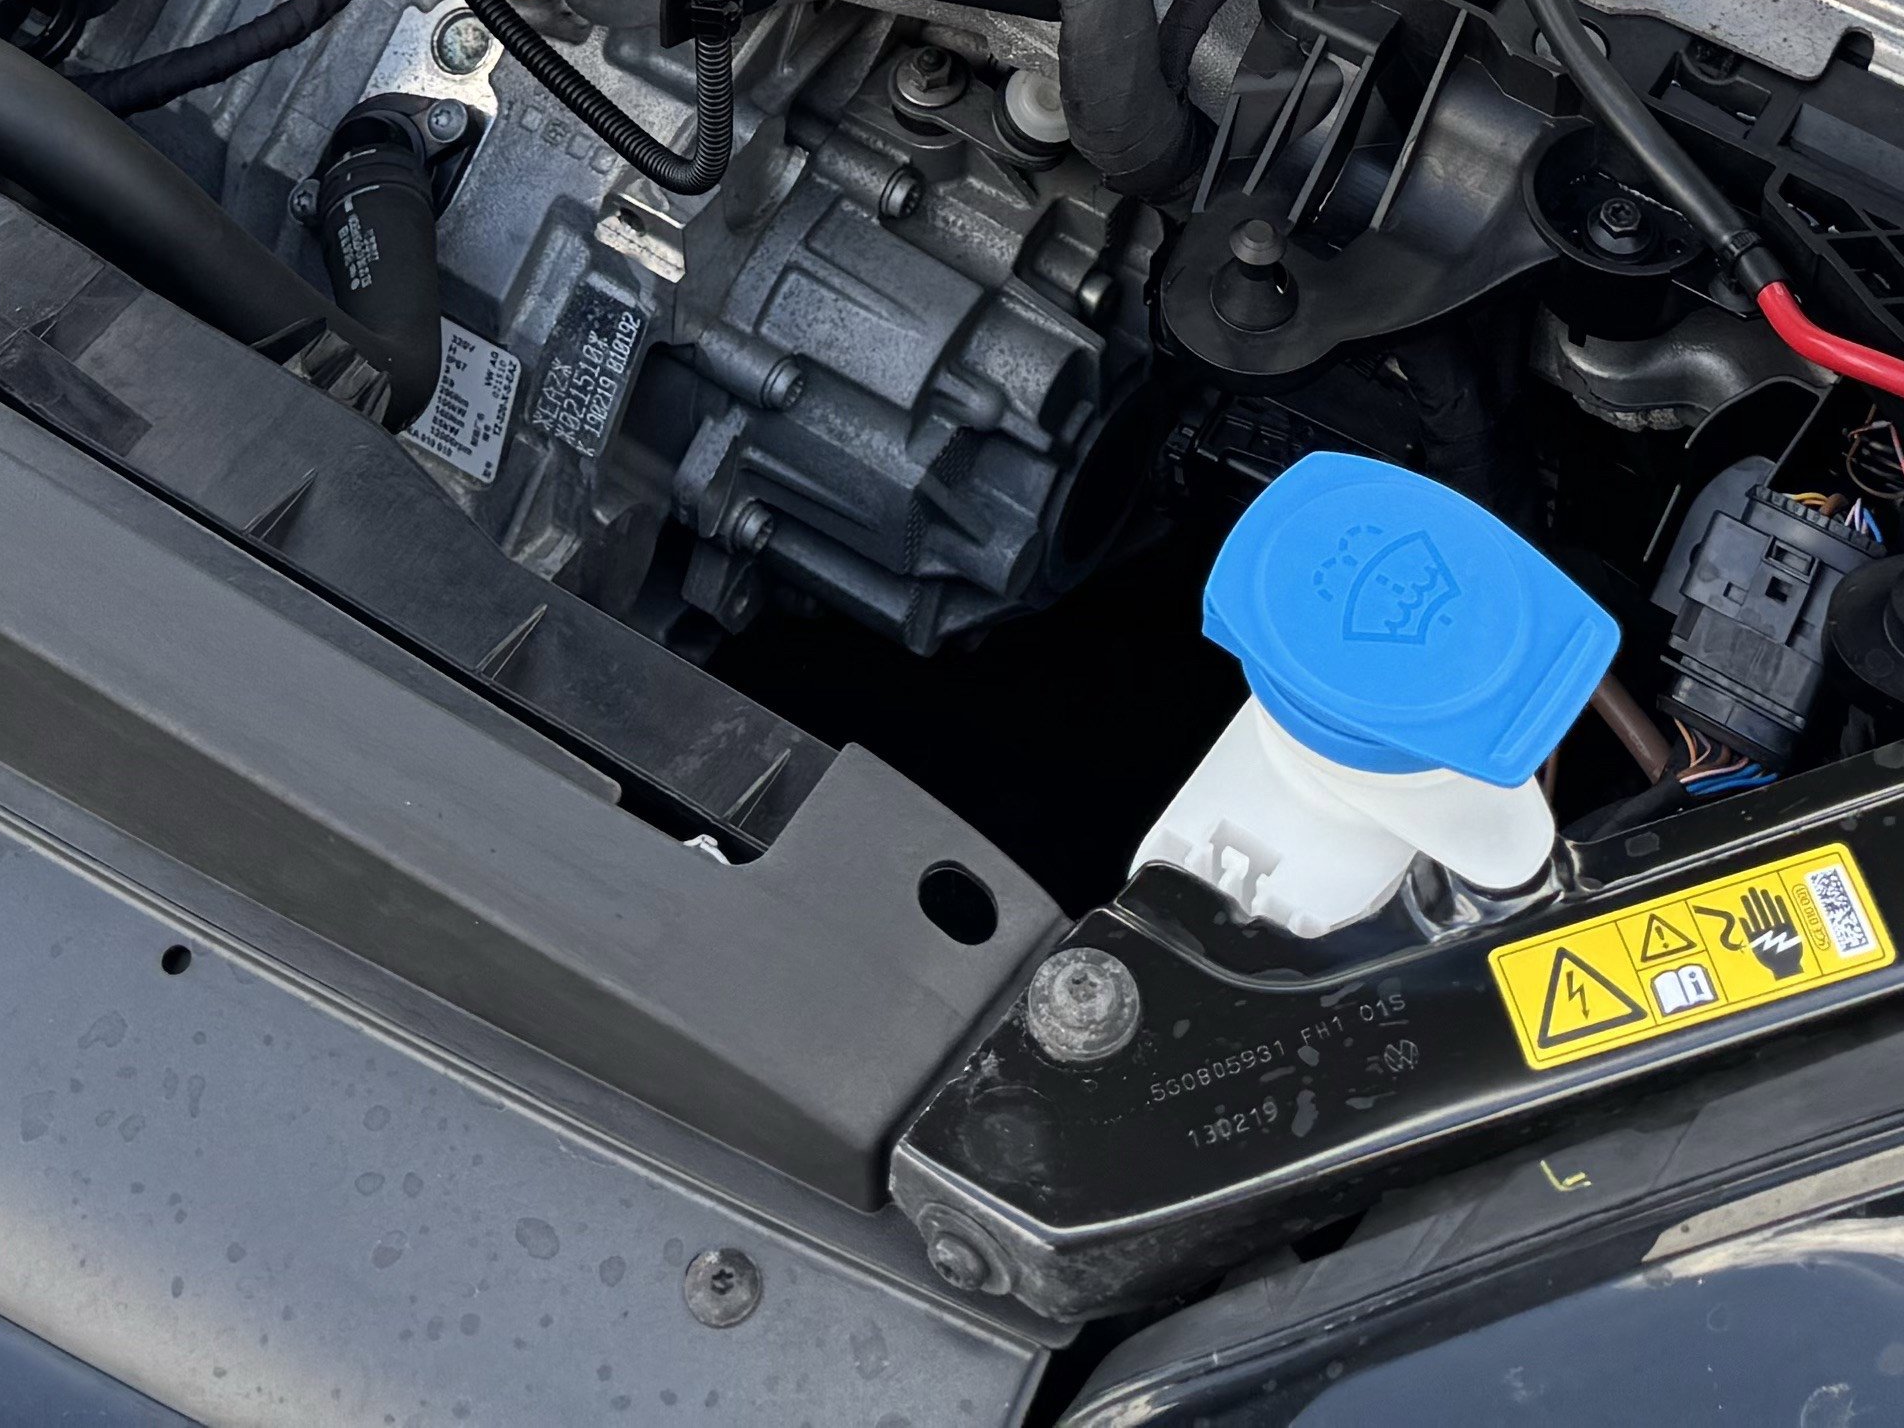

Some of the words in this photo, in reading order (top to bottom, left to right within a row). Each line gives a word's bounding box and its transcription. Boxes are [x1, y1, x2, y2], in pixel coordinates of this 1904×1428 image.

[1149, 1040, 1287, 1102] 5G0805931
[1300, 1016, 1343, 1044] FH1
[1189, 1101, 1279, 1147] 130219
